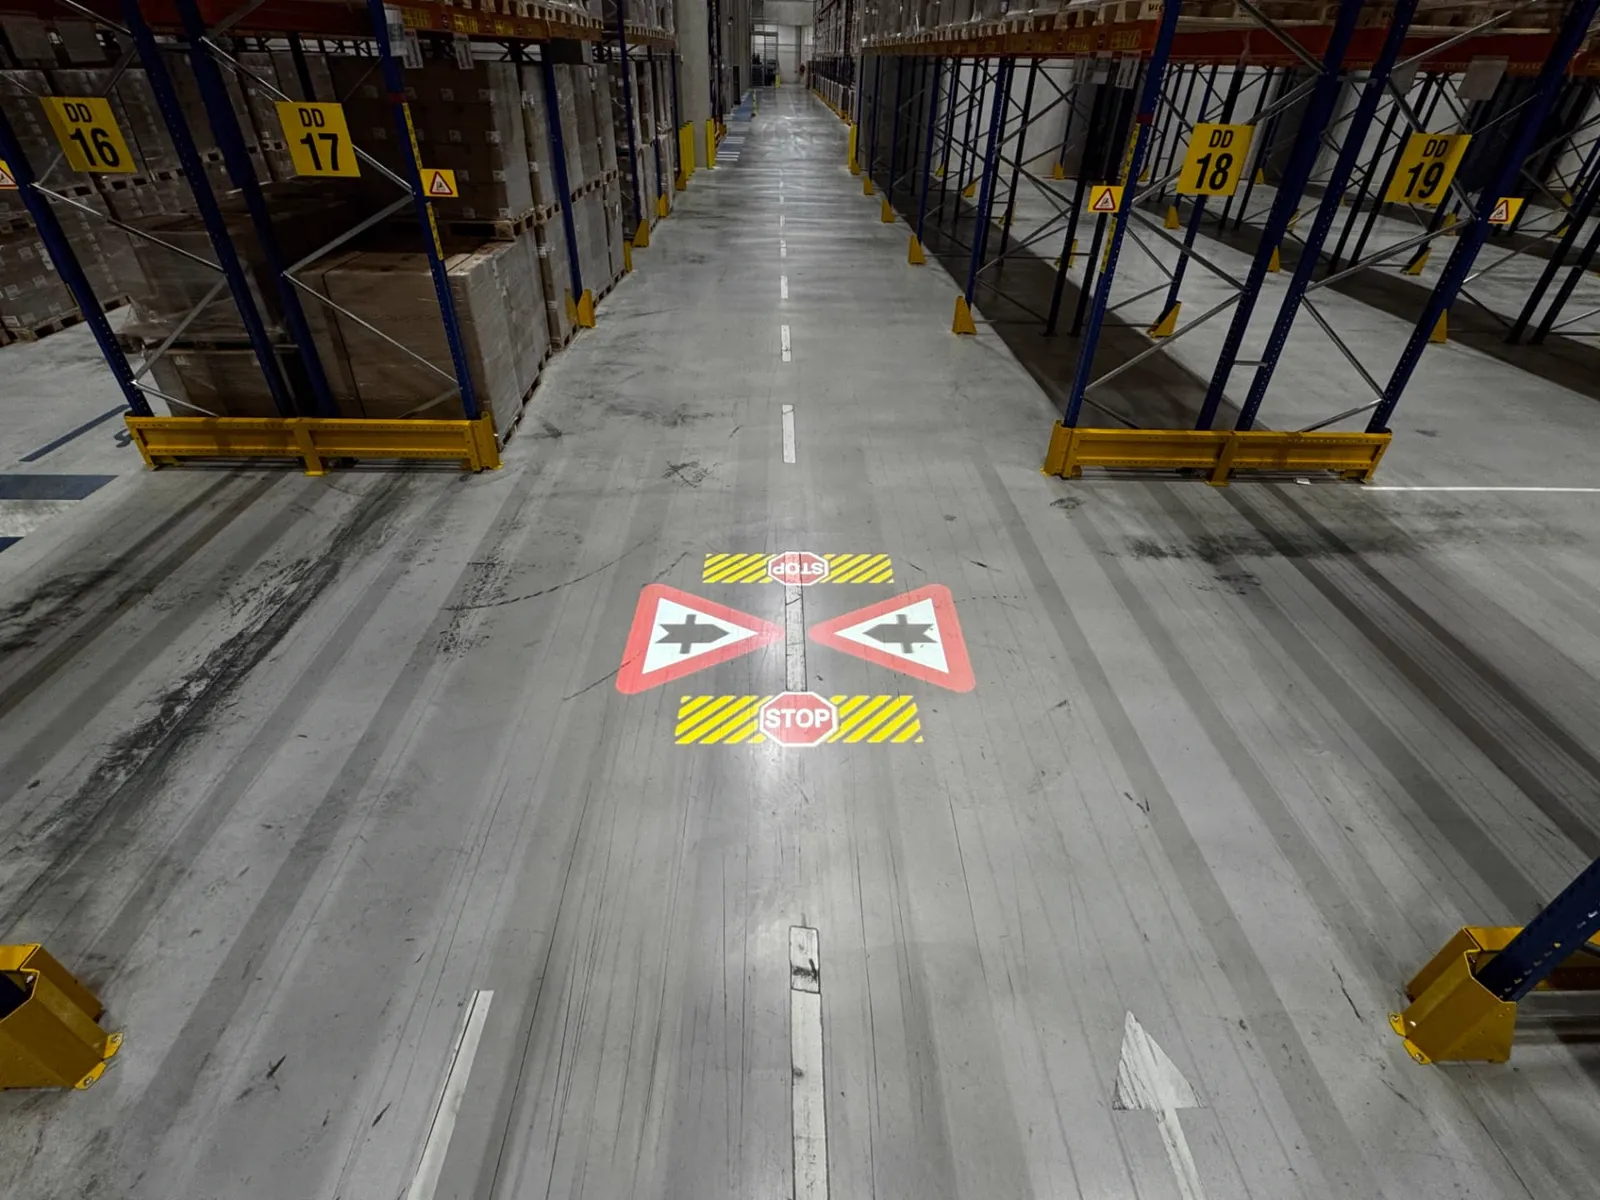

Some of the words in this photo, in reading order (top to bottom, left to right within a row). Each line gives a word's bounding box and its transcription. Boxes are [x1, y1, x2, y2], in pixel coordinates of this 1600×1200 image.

[63, 103, 93, 124] DD
[298, 108, 325, 128] DD
[69, 128, 120, 168] 16
[1208, 129, 1234, 148] DD
[1422, 139, 1448, 158] DD
[300, 132, 340, 172] 17
[1195, 152, 1230, 191] 18
[1403, 162, 1445, 199] 19
[772, 562, 825, 575] STOP
[764, 708, 831, 728] STOP
